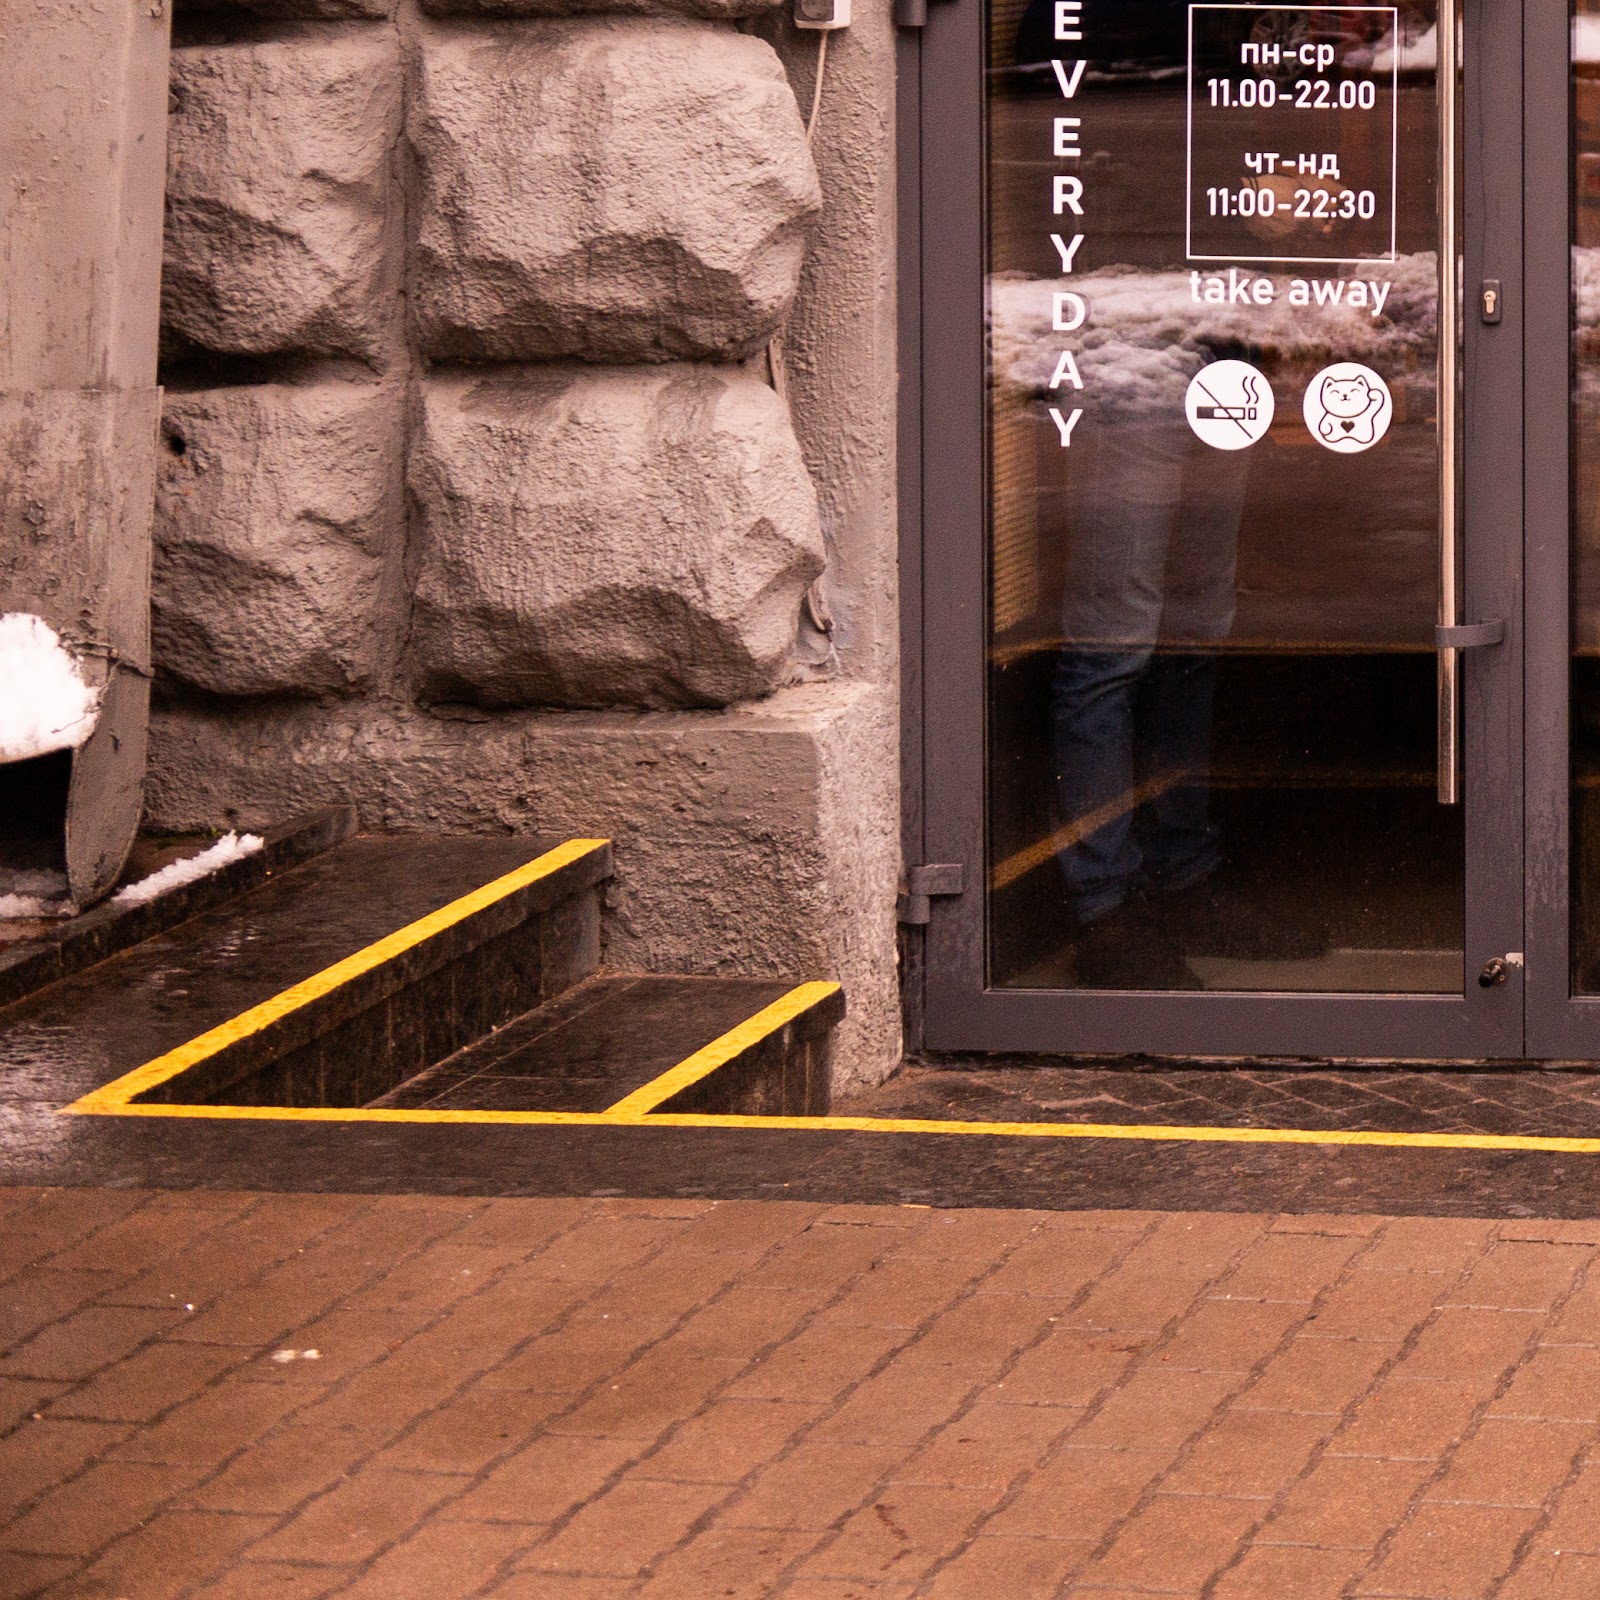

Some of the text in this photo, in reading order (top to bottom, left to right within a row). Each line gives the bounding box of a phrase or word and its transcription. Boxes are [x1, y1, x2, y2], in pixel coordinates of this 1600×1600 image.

[1240, 42, 1336, 70] пн-ср
[1206, 77, 1376, 110] 11.00-22.00
[1244, 150, 1341, 180] чт-нд
[1205, 186, 1376, 220] 11:00-22:30
[1188, 269, 1391, 317] take away
